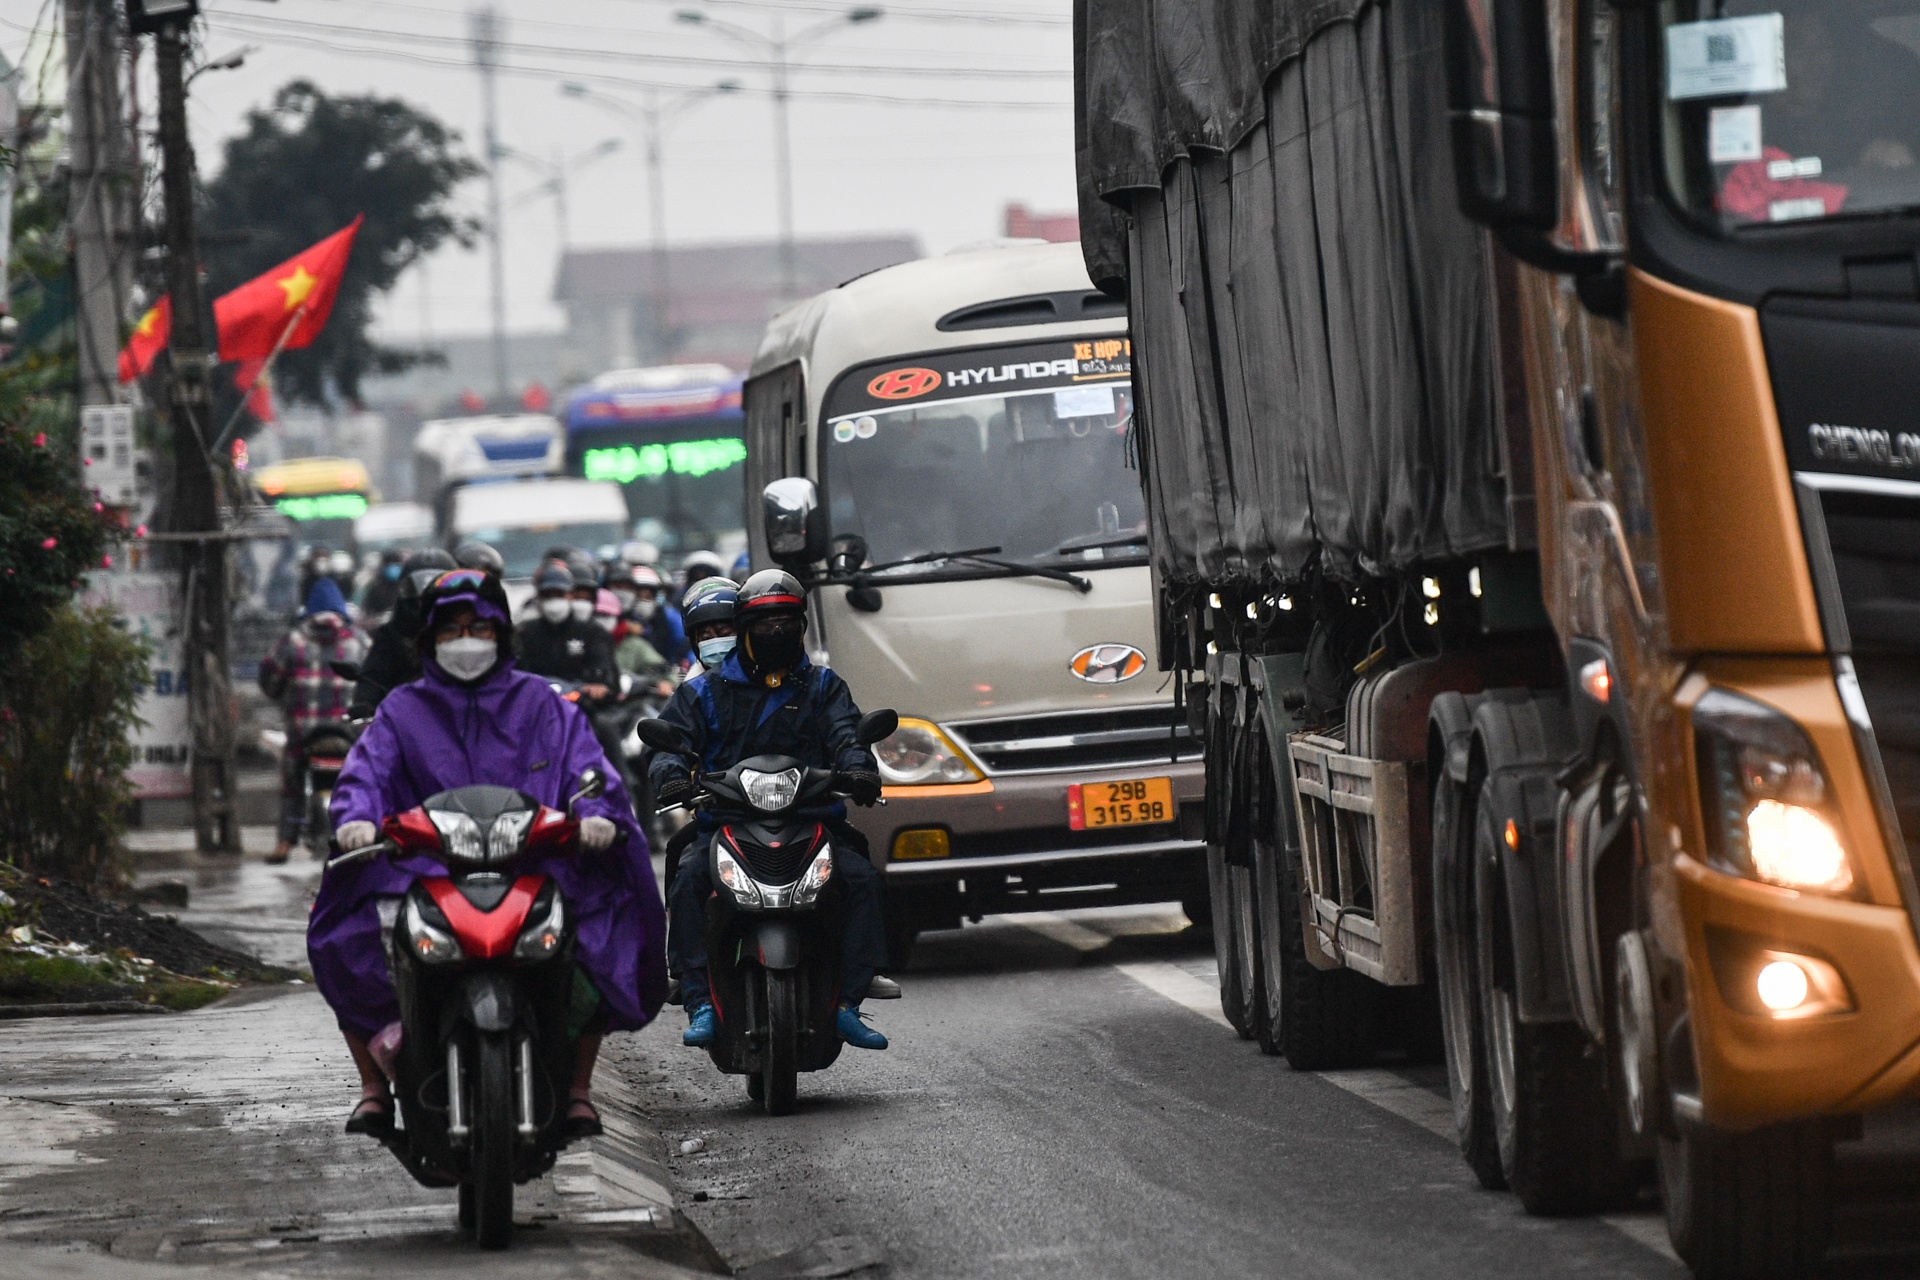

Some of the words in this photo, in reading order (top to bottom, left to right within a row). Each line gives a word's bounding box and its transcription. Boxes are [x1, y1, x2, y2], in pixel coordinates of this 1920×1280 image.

[1074, 342, 1092, 360] XE
[947, 358, 1079, 387] HYUNDAI
[1108, 781, 1146, 802] 29B
